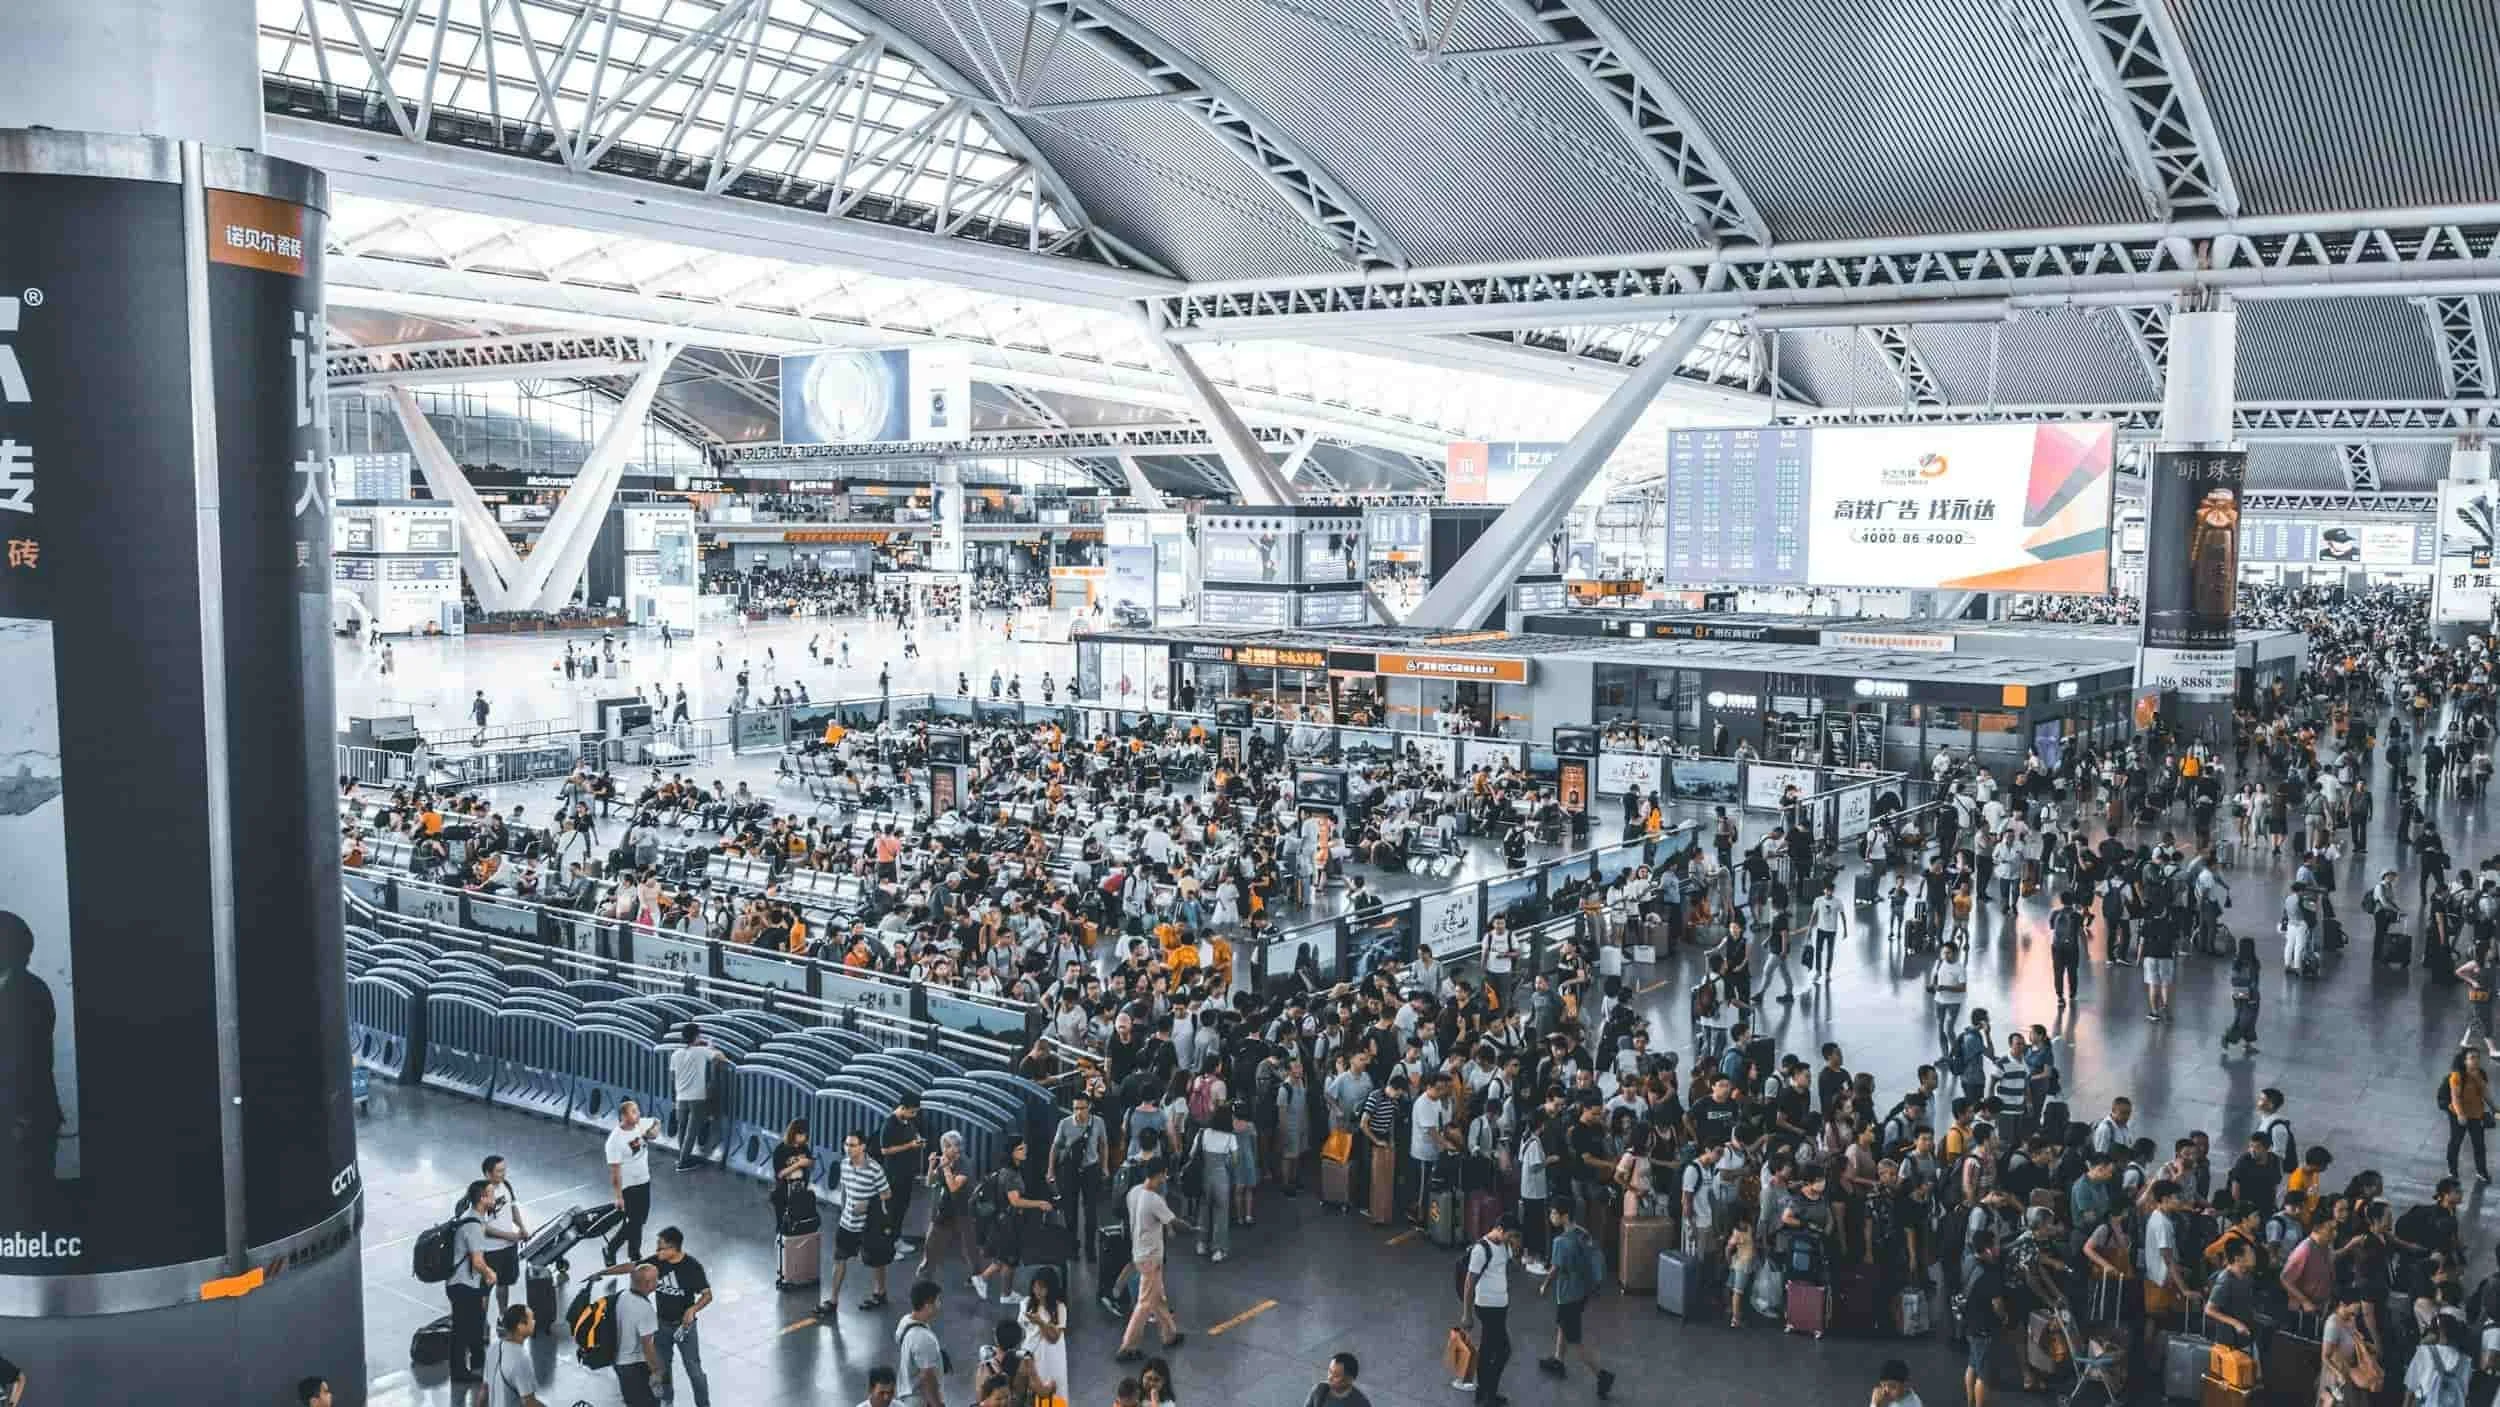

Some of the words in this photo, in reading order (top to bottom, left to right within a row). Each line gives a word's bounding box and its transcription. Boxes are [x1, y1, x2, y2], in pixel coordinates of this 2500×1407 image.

[225, 224, 275, 253] 诺贝尔
[1833, 498, 1920, 520] 高铁广告
[1862, 533, 1897, 544] 4000
[1927, 534, 1964, 544] 4000
